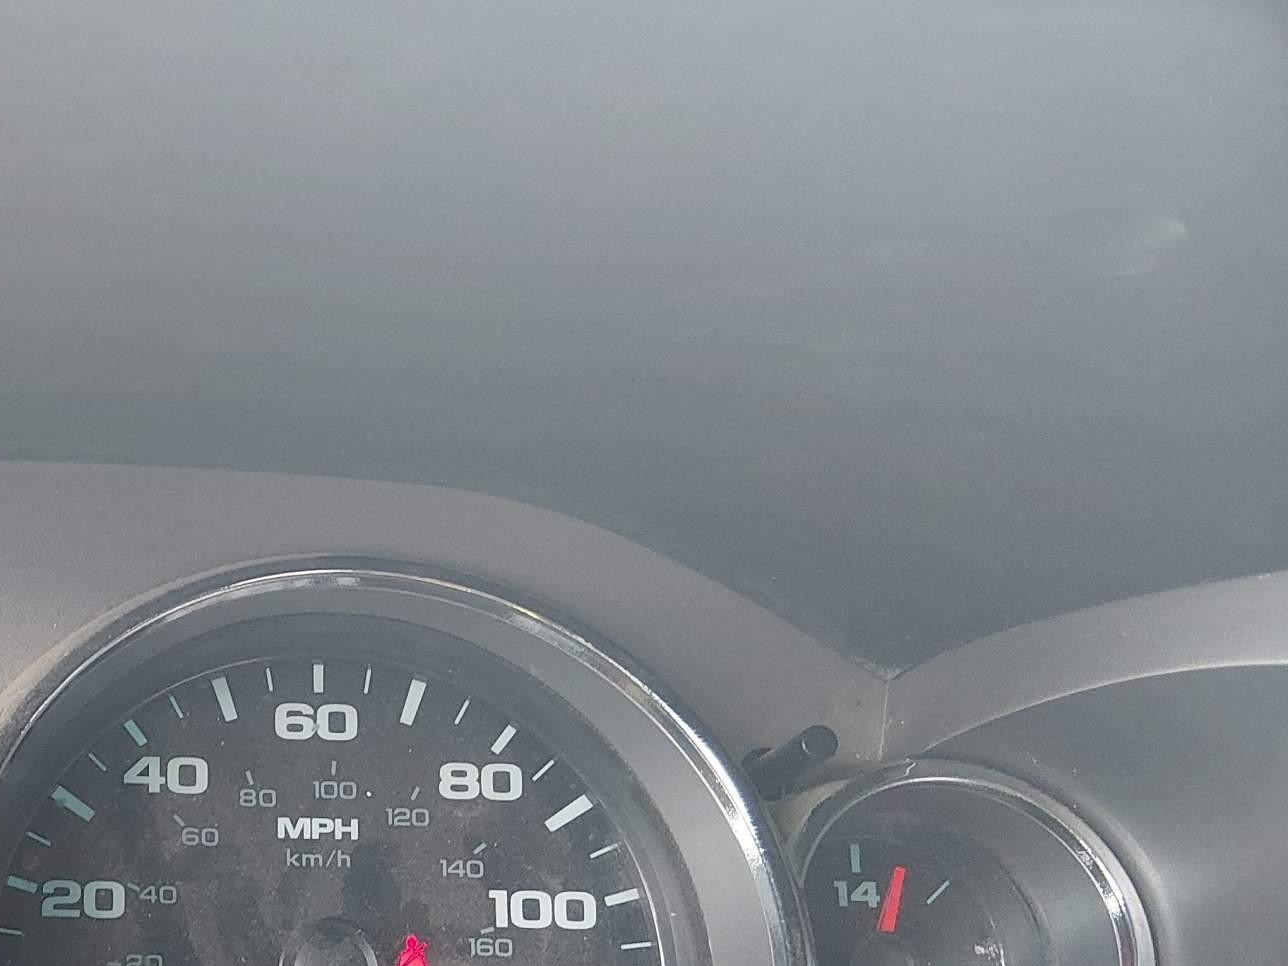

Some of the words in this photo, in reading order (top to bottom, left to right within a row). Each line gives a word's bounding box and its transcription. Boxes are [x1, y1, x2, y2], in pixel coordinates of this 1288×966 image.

[274, 703, 359, 740] 60
[124, 756, 209, 794] 40
[438, 763, 523, 801] 80
[238, 788, 277, 808] 80
[313, 781, 358, 800] 100
[385, 808, 430, 828] 120
[181, 827, 220, 847] 60
[277, 817, 360, 841] MPH
[285, 849, 352, 868] km/h
[440, 859, 484, 879] 140
[41, 880, 126, 918] 20
[139, 884, 178, 904] 40
[834, 880, 880, 907] 14
[488, 890, 597, 929] 100
[468, 938, 513, 957] 160
